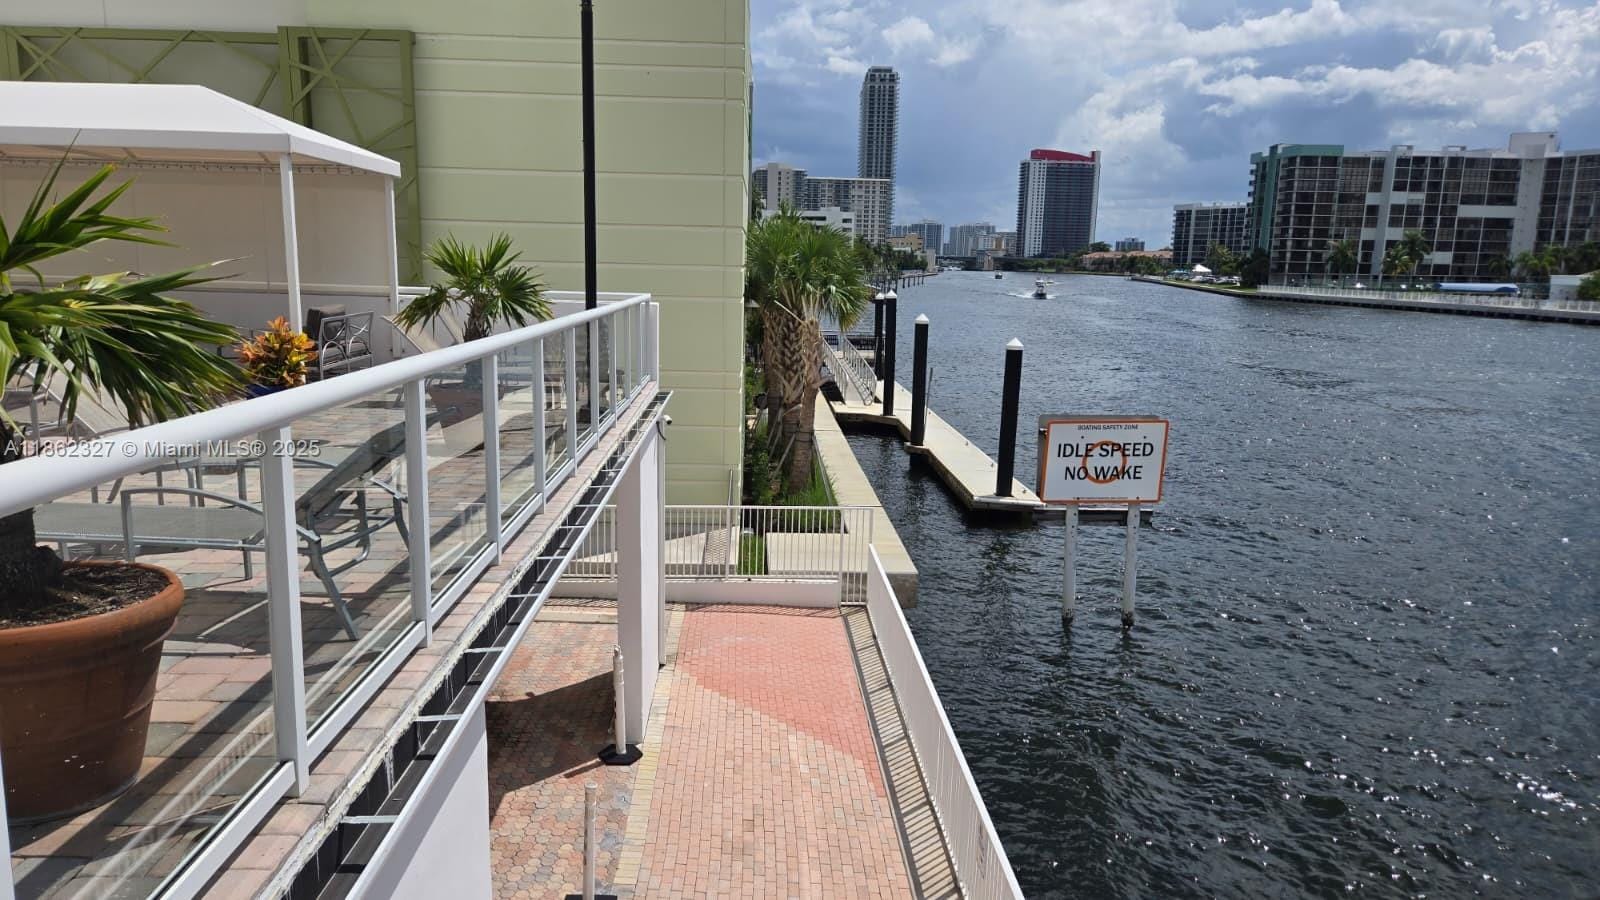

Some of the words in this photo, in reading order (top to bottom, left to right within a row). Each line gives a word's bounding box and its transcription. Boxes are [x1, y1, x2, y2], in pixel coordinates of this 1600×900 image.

[1057, 443, 1094, 458] IDLE
[1098, 442, 1154, 458] SPEED
[1064, 466, 1089, 480] NO
[1093, 465, 1143, 480] WAKE
